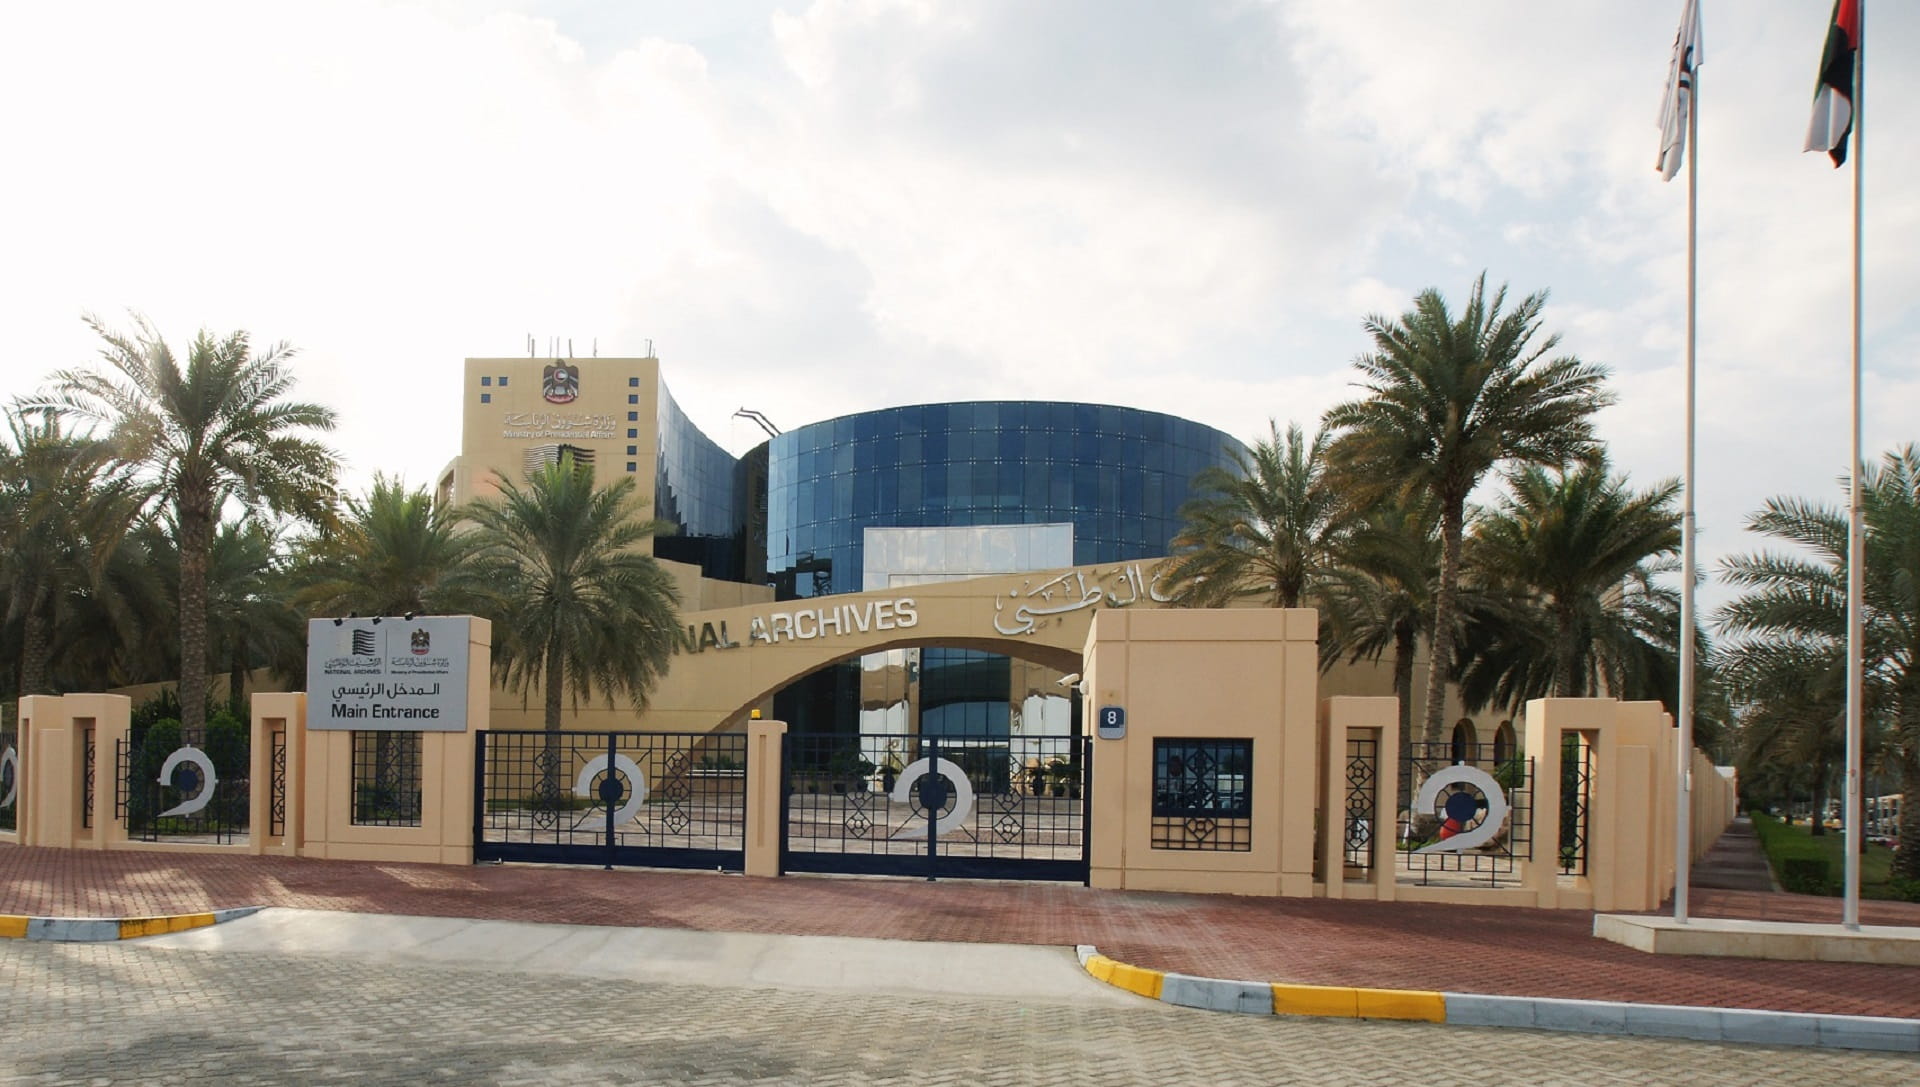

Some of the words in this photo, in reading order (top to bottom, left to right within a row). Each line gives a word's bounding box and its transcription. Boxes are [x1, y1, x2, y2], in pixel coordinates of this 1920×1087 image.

[503, 430, 534, 440] Ministry
[750, 598, 919, 647] ARCHIVES
[332, 682, 384, 702] الرئيسي
[386, 682, 440, 699] المدخل
[331, 703, 368, 718] Main
[372, 703, 440, 719] Entrance
[1107, 710, 1117, 725] 8
